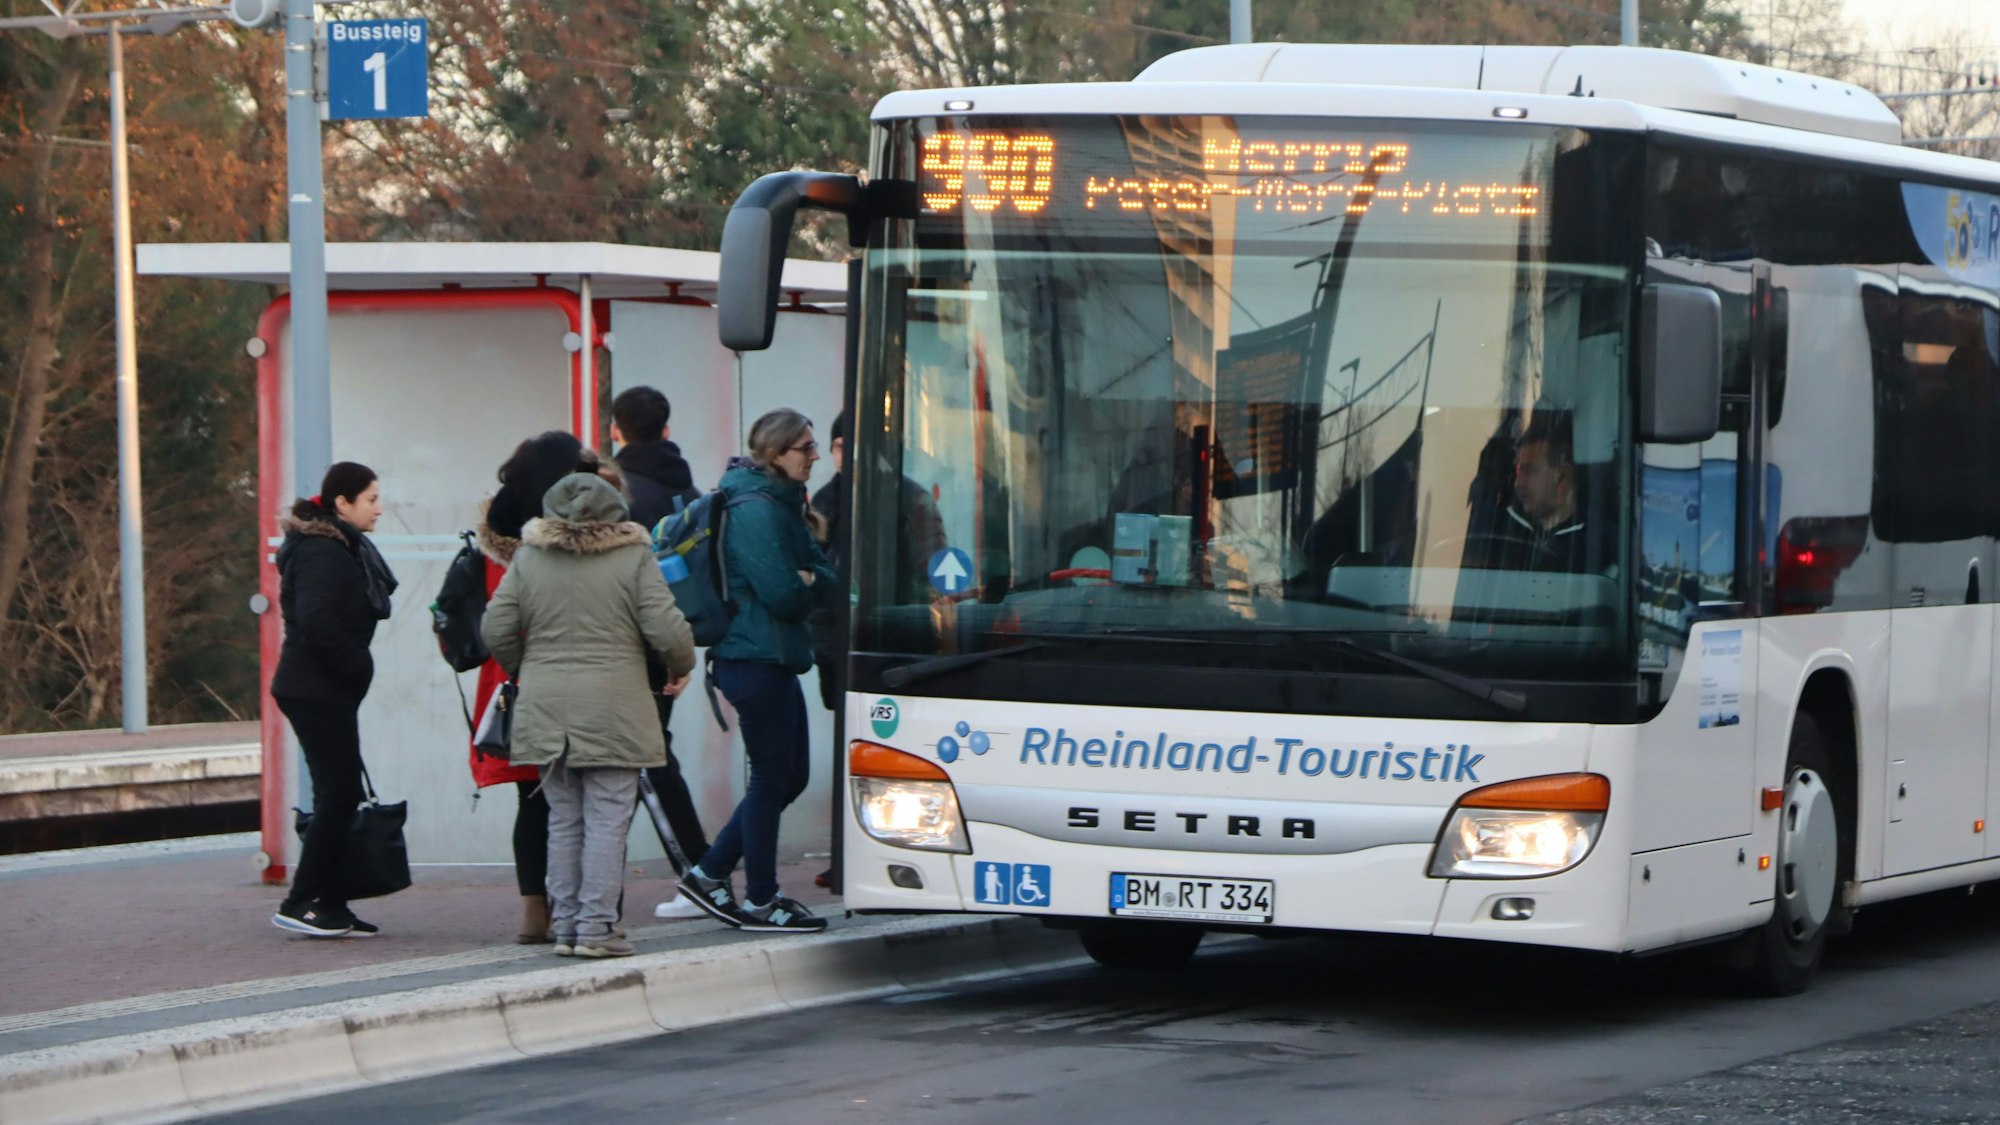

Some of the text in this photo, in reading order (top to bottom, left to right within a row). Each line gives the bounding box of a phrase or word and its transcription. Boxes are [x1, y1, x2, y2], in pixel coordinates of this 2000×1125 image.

[333, 21, 421, 43] Bussteig
[363, 52, 387, 111] 1
[923, 133, 1054, 211] 990
[870, 706, 892, 719] VRS
[1019, 727, 1486, 782] Rheinland-Touristik
[1067, 806, 1315, 839] SETRA
[1126, 879, 1269, 912] BM RT 334
